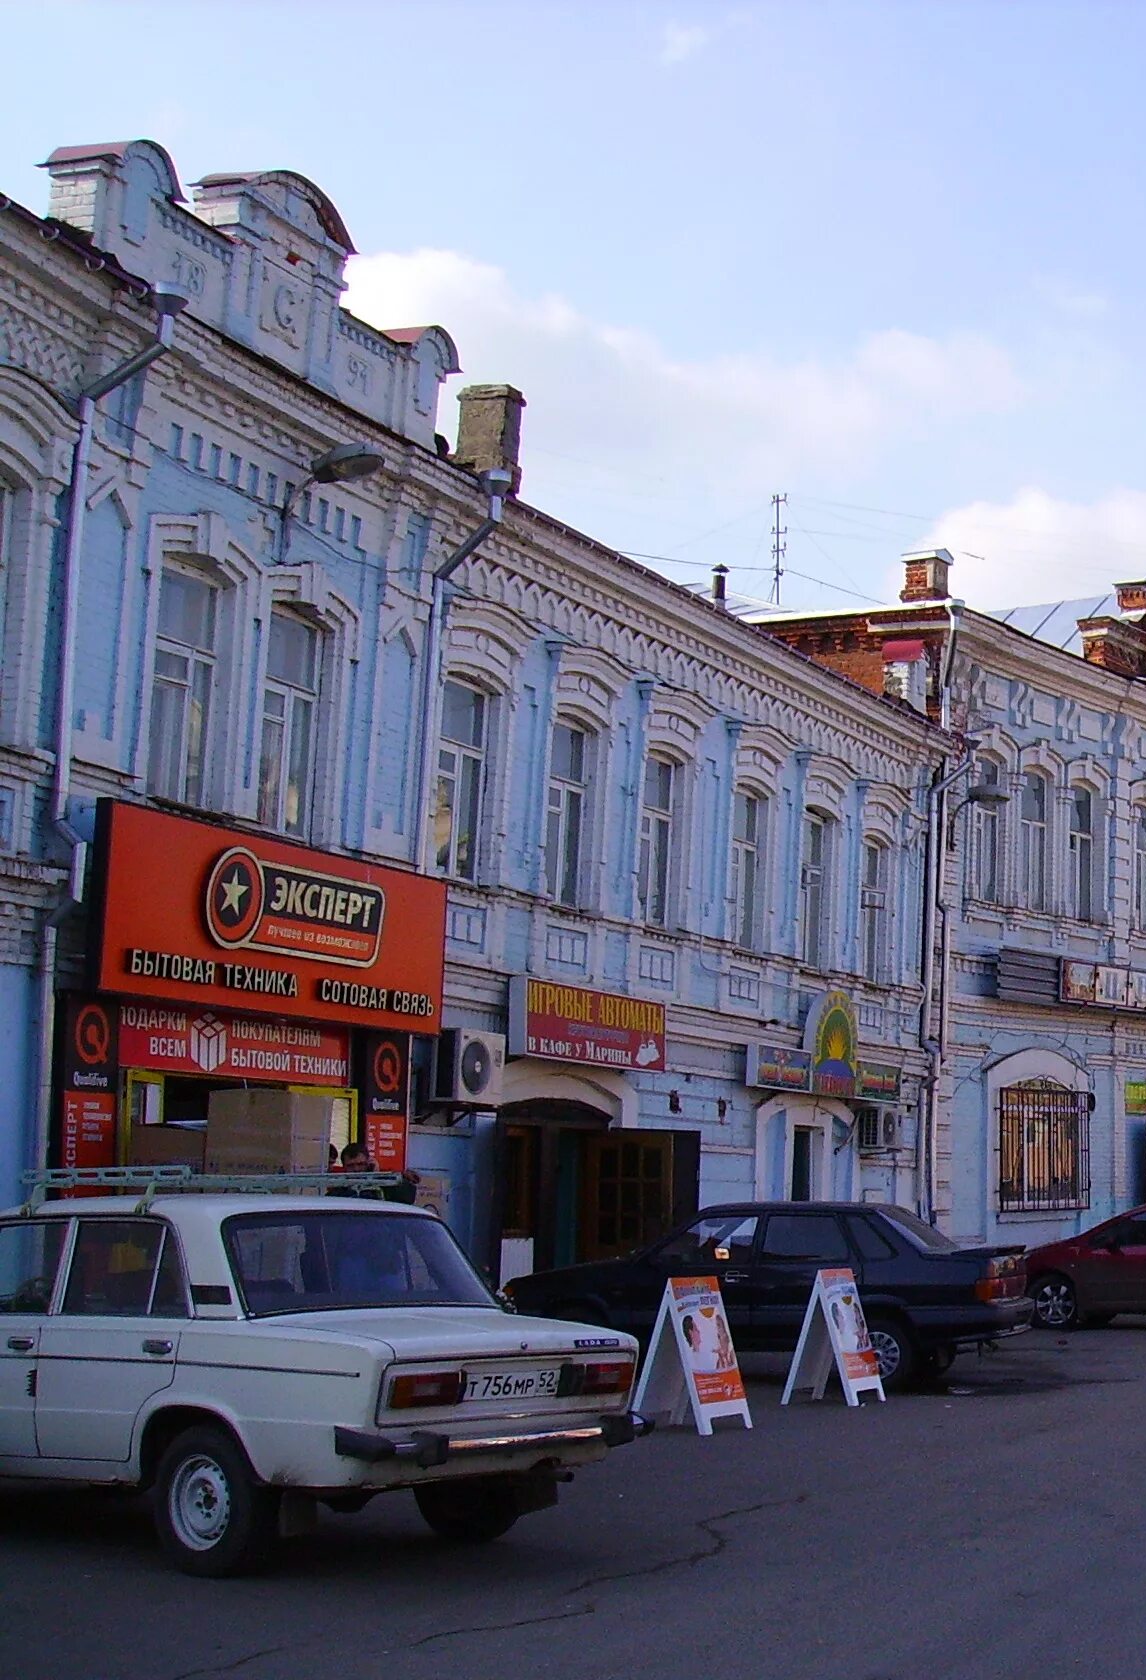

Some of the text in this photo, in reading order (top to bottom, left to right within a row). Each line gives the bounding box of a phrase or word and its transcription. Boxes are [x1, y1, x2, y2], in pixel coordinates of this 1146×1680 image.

[270, 877, 376, 928] ЭКСПЕРТ
[131, 949, 434, 1017] БЫТОВАЯ ТЕХНИКА СОТОВАЯ СВЯЗЬ
[528, 981, 594, 1023] ИГРОВЫЕ
[599, 995, 664, 1035] АВТОМАТЫ
[149, 1036, 187, 1058] ВСЕМ
[231, 1019, 321, 1048] ПОКУПАТЕЛЯМ
[528, 1036, 536, 1051] В
[539, 1037, 572, 1056] КАФЕ
[231, 1047, 347, 1077] БЫТОВОЙ ТЕХНИКИ
